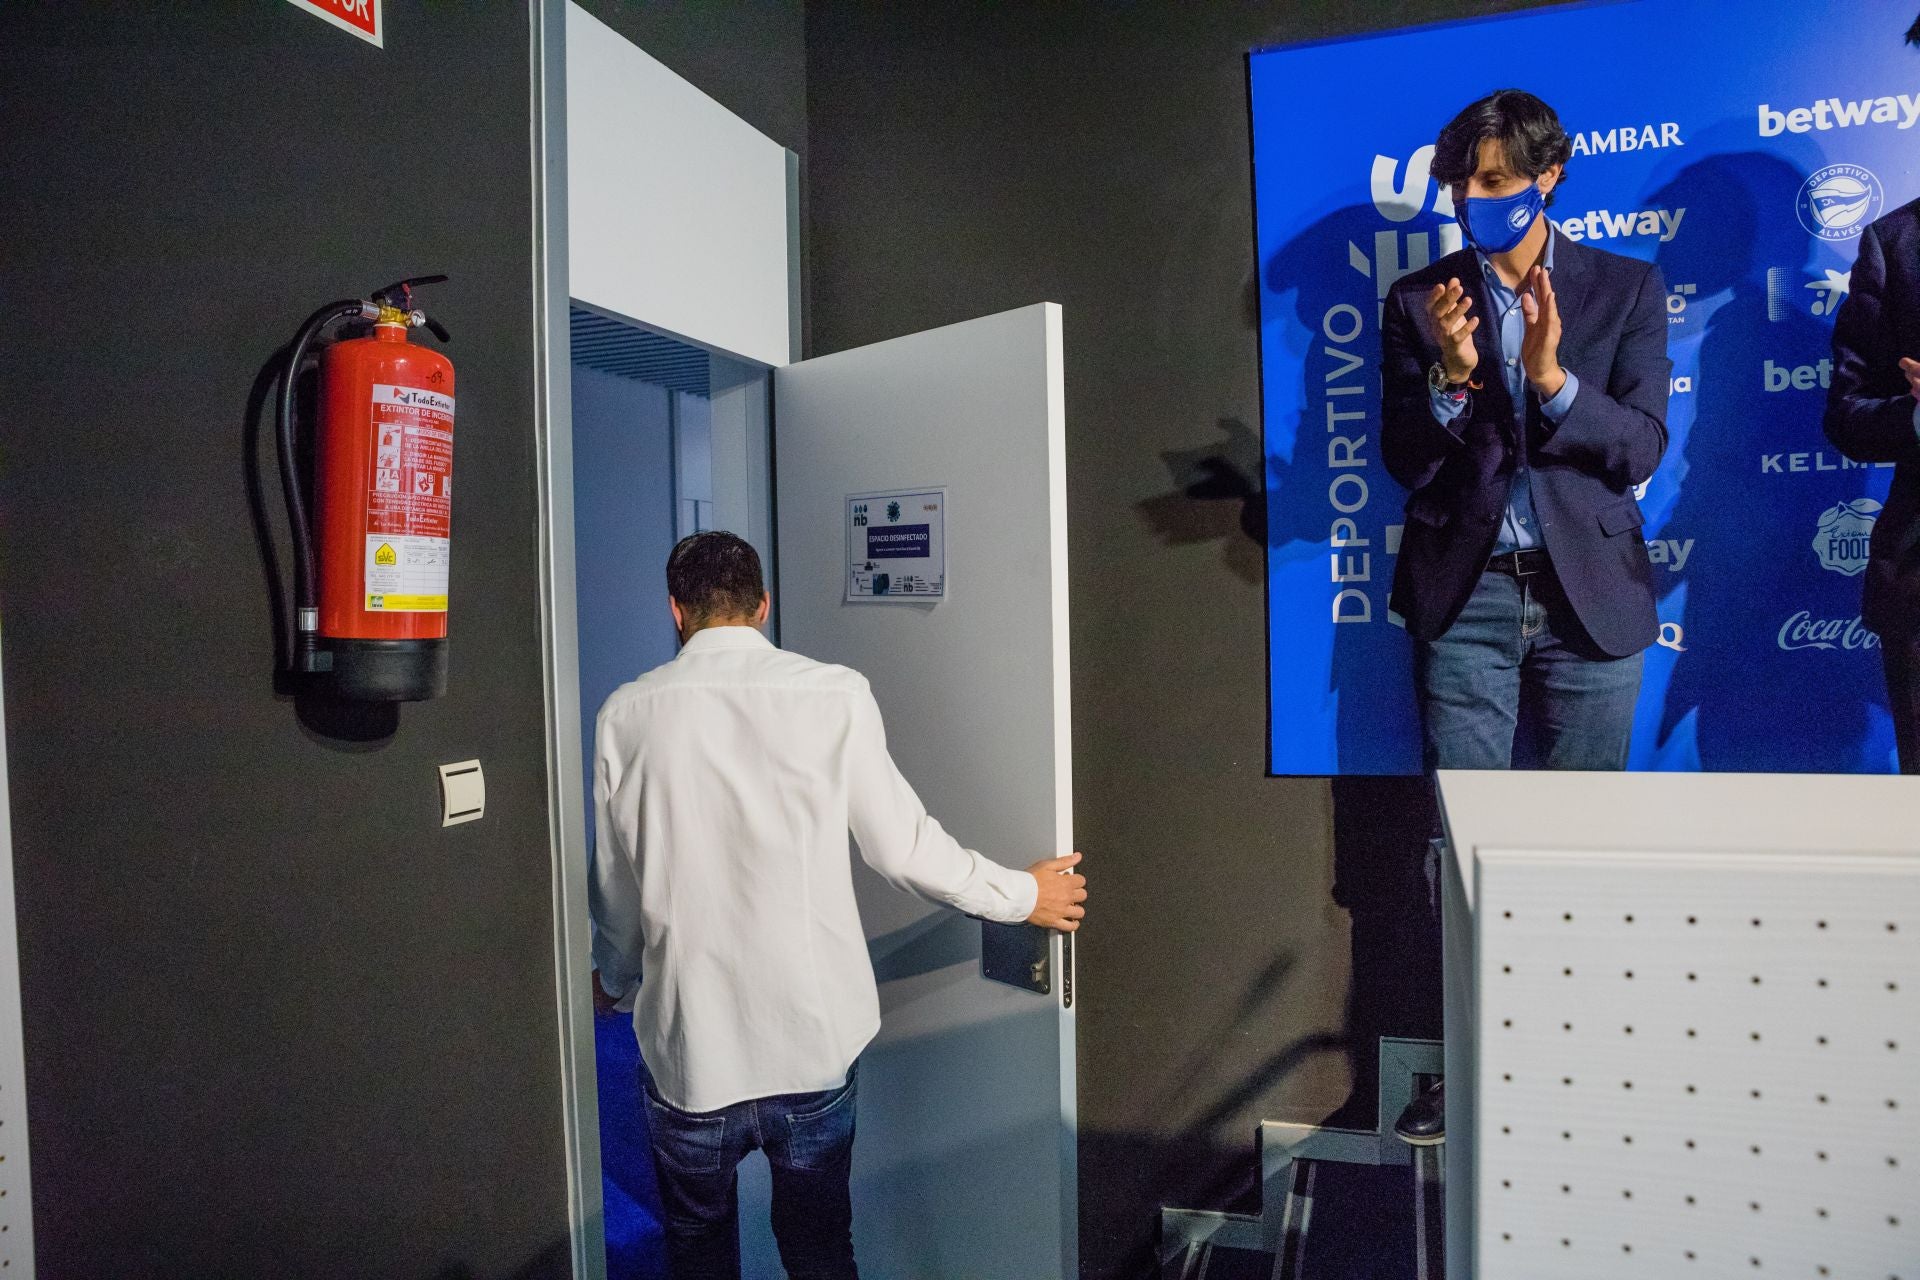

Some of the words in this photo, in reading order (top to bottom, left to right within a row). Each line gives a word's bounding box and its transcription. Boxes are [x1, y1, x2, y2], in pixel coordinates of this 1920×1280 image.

[1758, 93, 1920, 137] betway
[1571, 122, 1685, 157] AMBAR
[1809, 167, 1869, 187] DEPORTIVO
[1763, 358, 1834, 393] bet
[380, 404, 420, 415] EXTINTOR
[421, 409, 431, 417] DE
[1323, 303, 1371, 623] DEPORTIVO
[853, 514, 867, 526] nb
[869, 534, 889, 543] ESPACIO
[889, 533, 928, 542] DESINFECTADO
[1645, 538, 1695, 572] ay
[1777, 610, 1882, 651] Coca-Co
